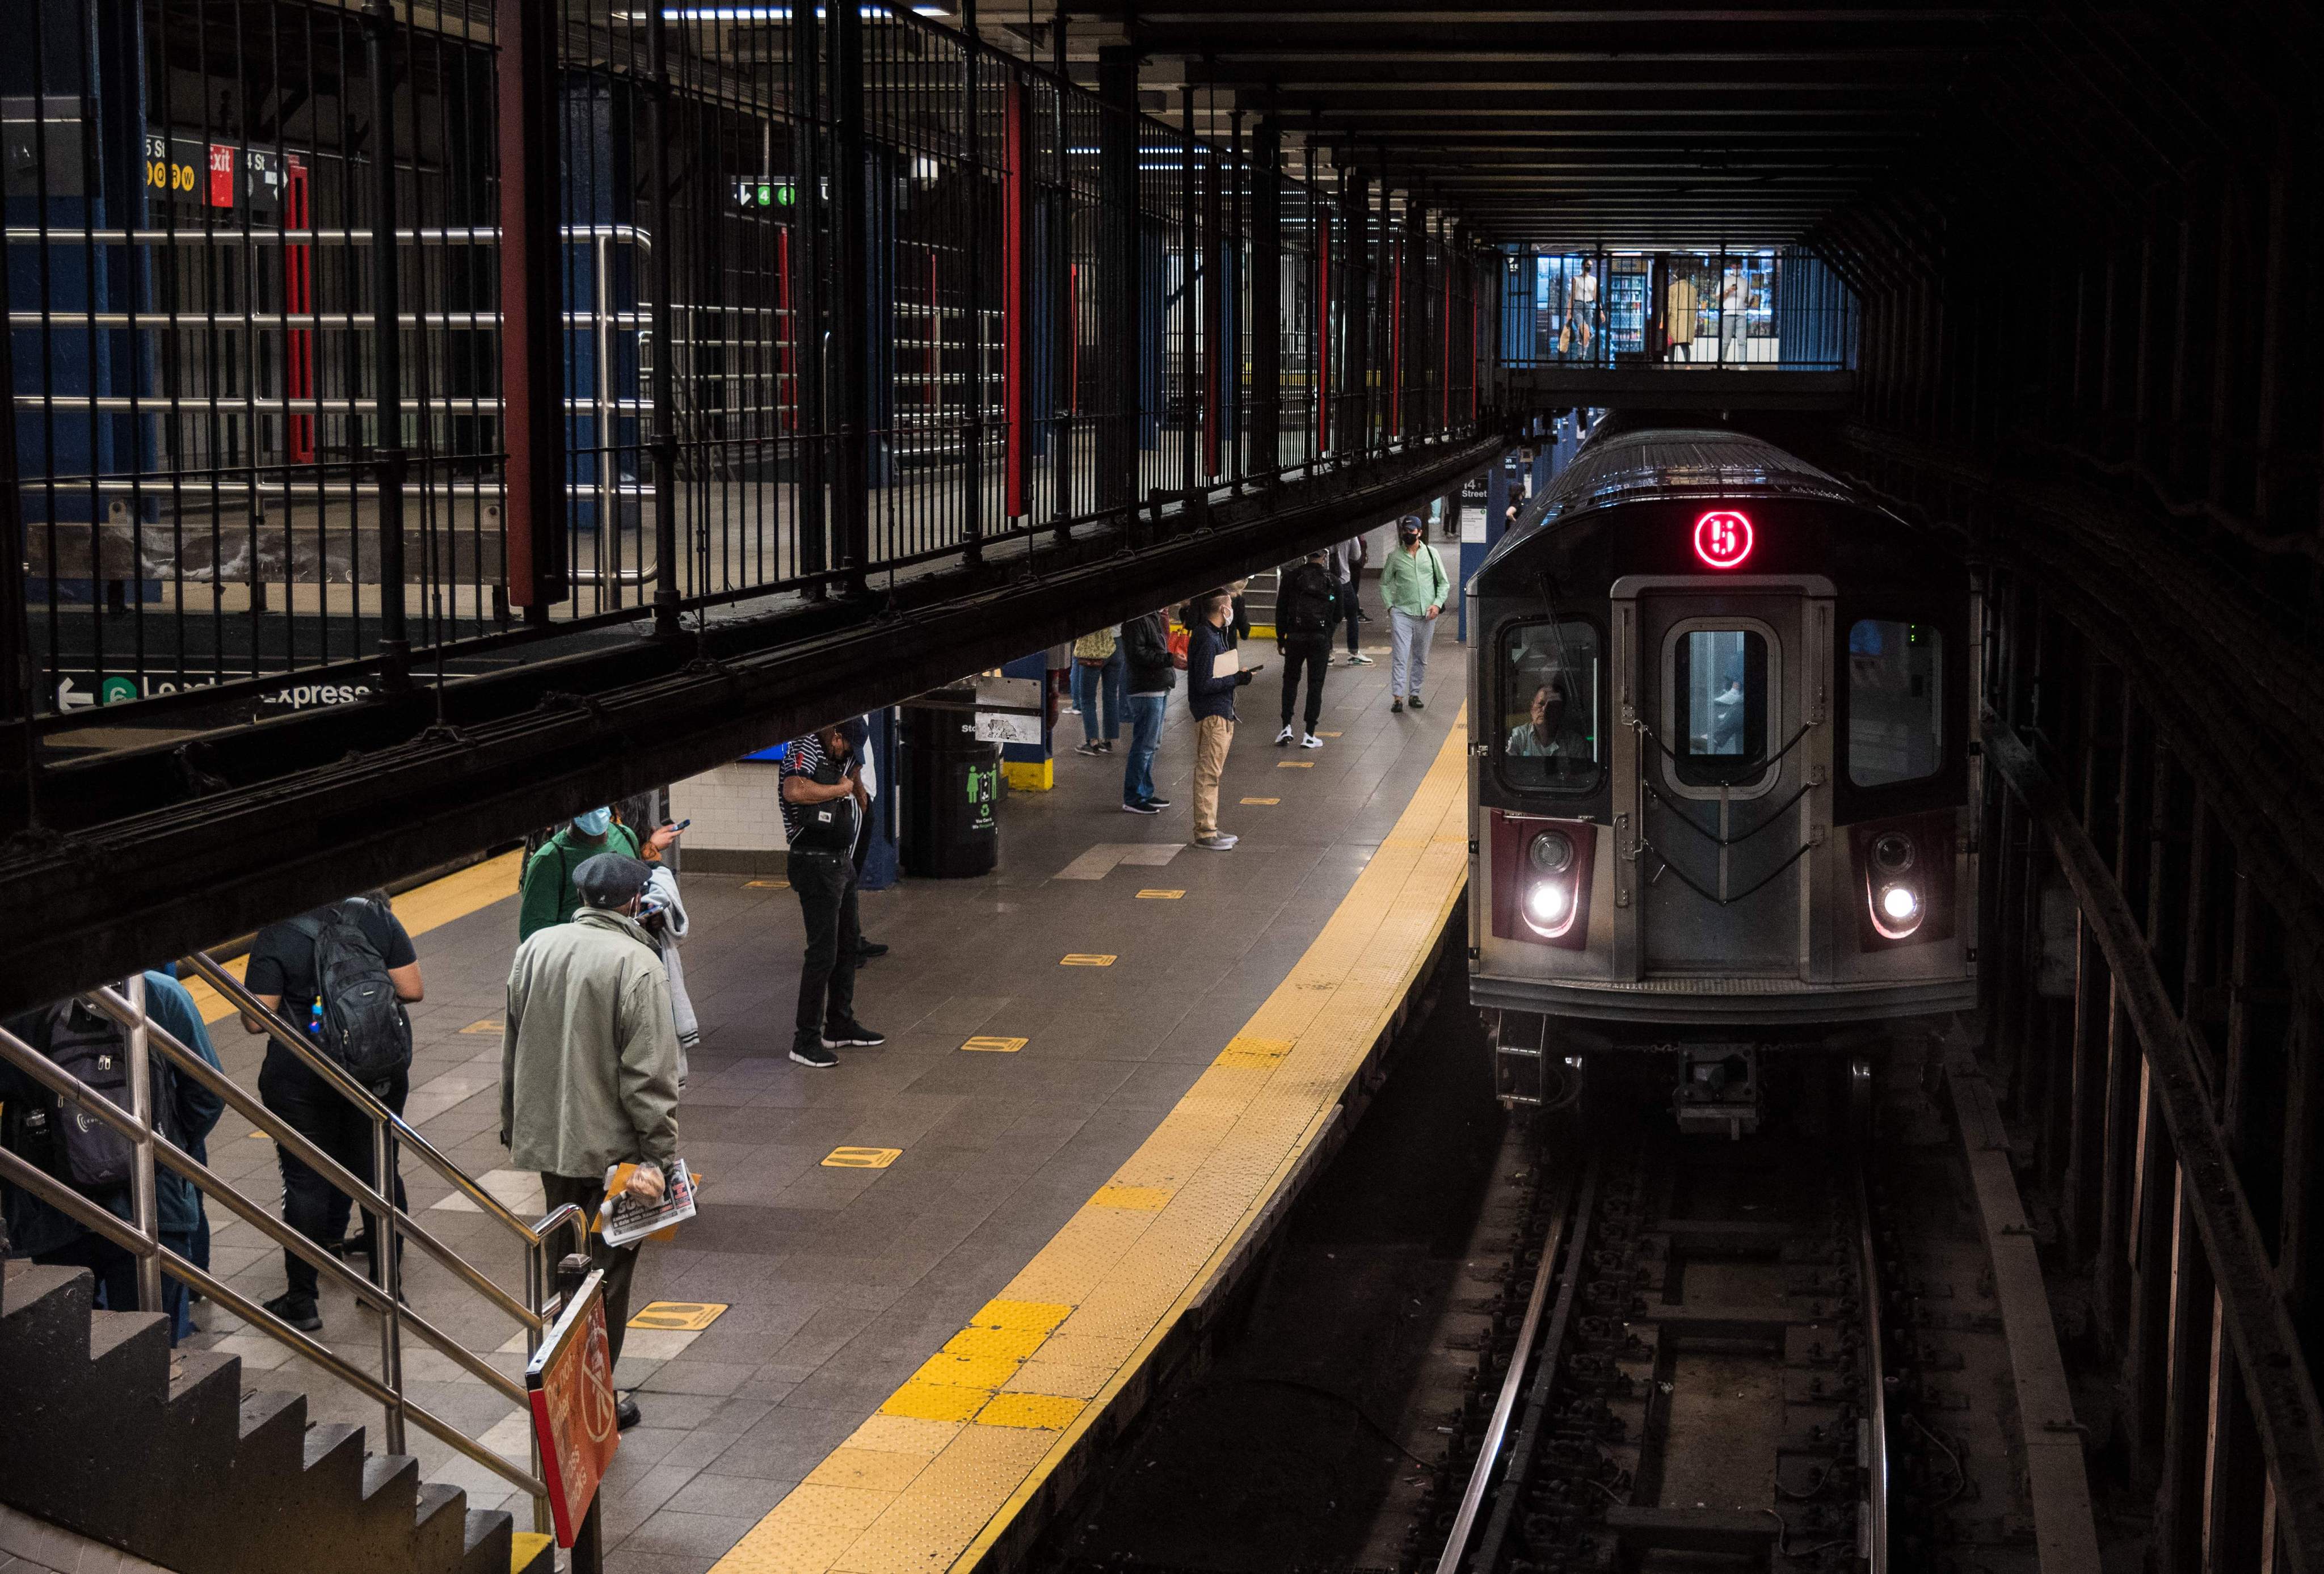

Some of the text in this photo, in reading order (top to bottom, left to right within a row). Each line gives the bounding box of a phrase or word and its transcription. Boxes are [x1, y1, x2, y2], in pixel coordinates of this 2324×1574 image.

[154, 142, 165, 158] St
[254, 154, 266, 171] St
[760, 190, 769, 201] 4
[262, 684, 372, 709] xpress
